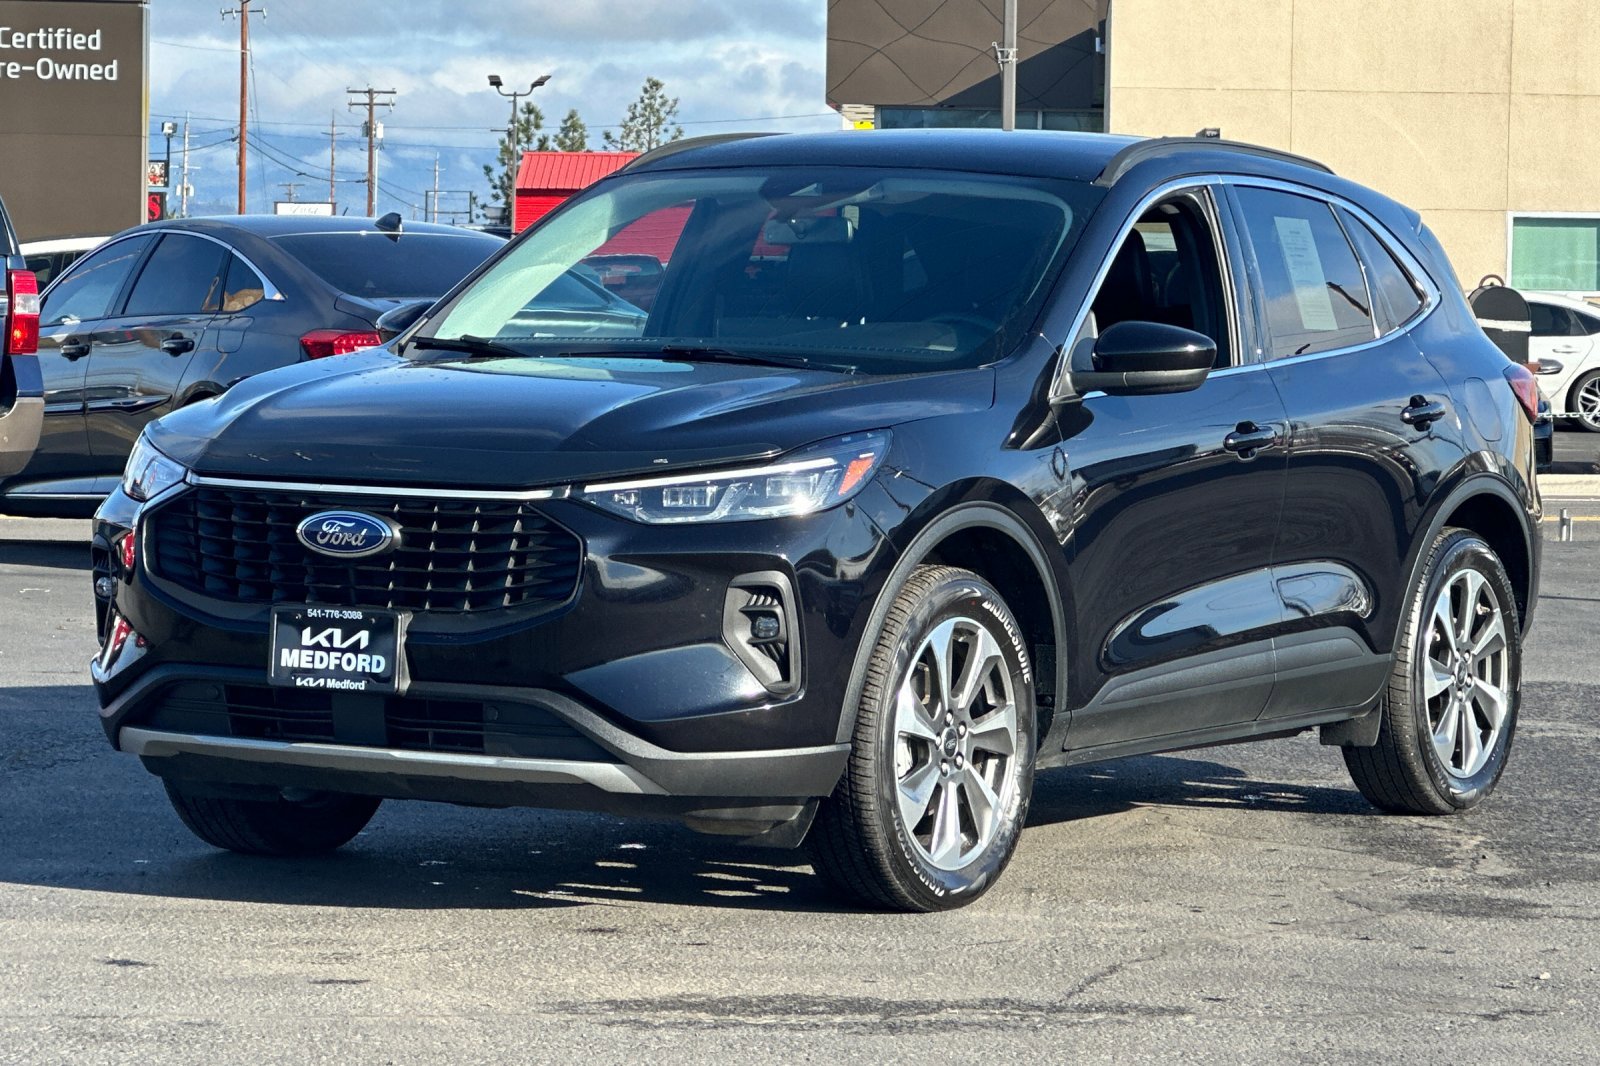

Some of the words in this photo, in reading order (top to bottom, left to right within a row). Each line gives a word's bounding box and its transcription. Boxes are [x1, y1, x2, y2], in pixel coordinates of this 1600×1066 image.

[0, 26, 101, 50] Certified
[316, 519, 367, 547] Ford
[307, 608, 363, 620] 541-776-3088
[281, 648, 386, 673] MEDFORD
[326, 678, 366, 690] Medford
